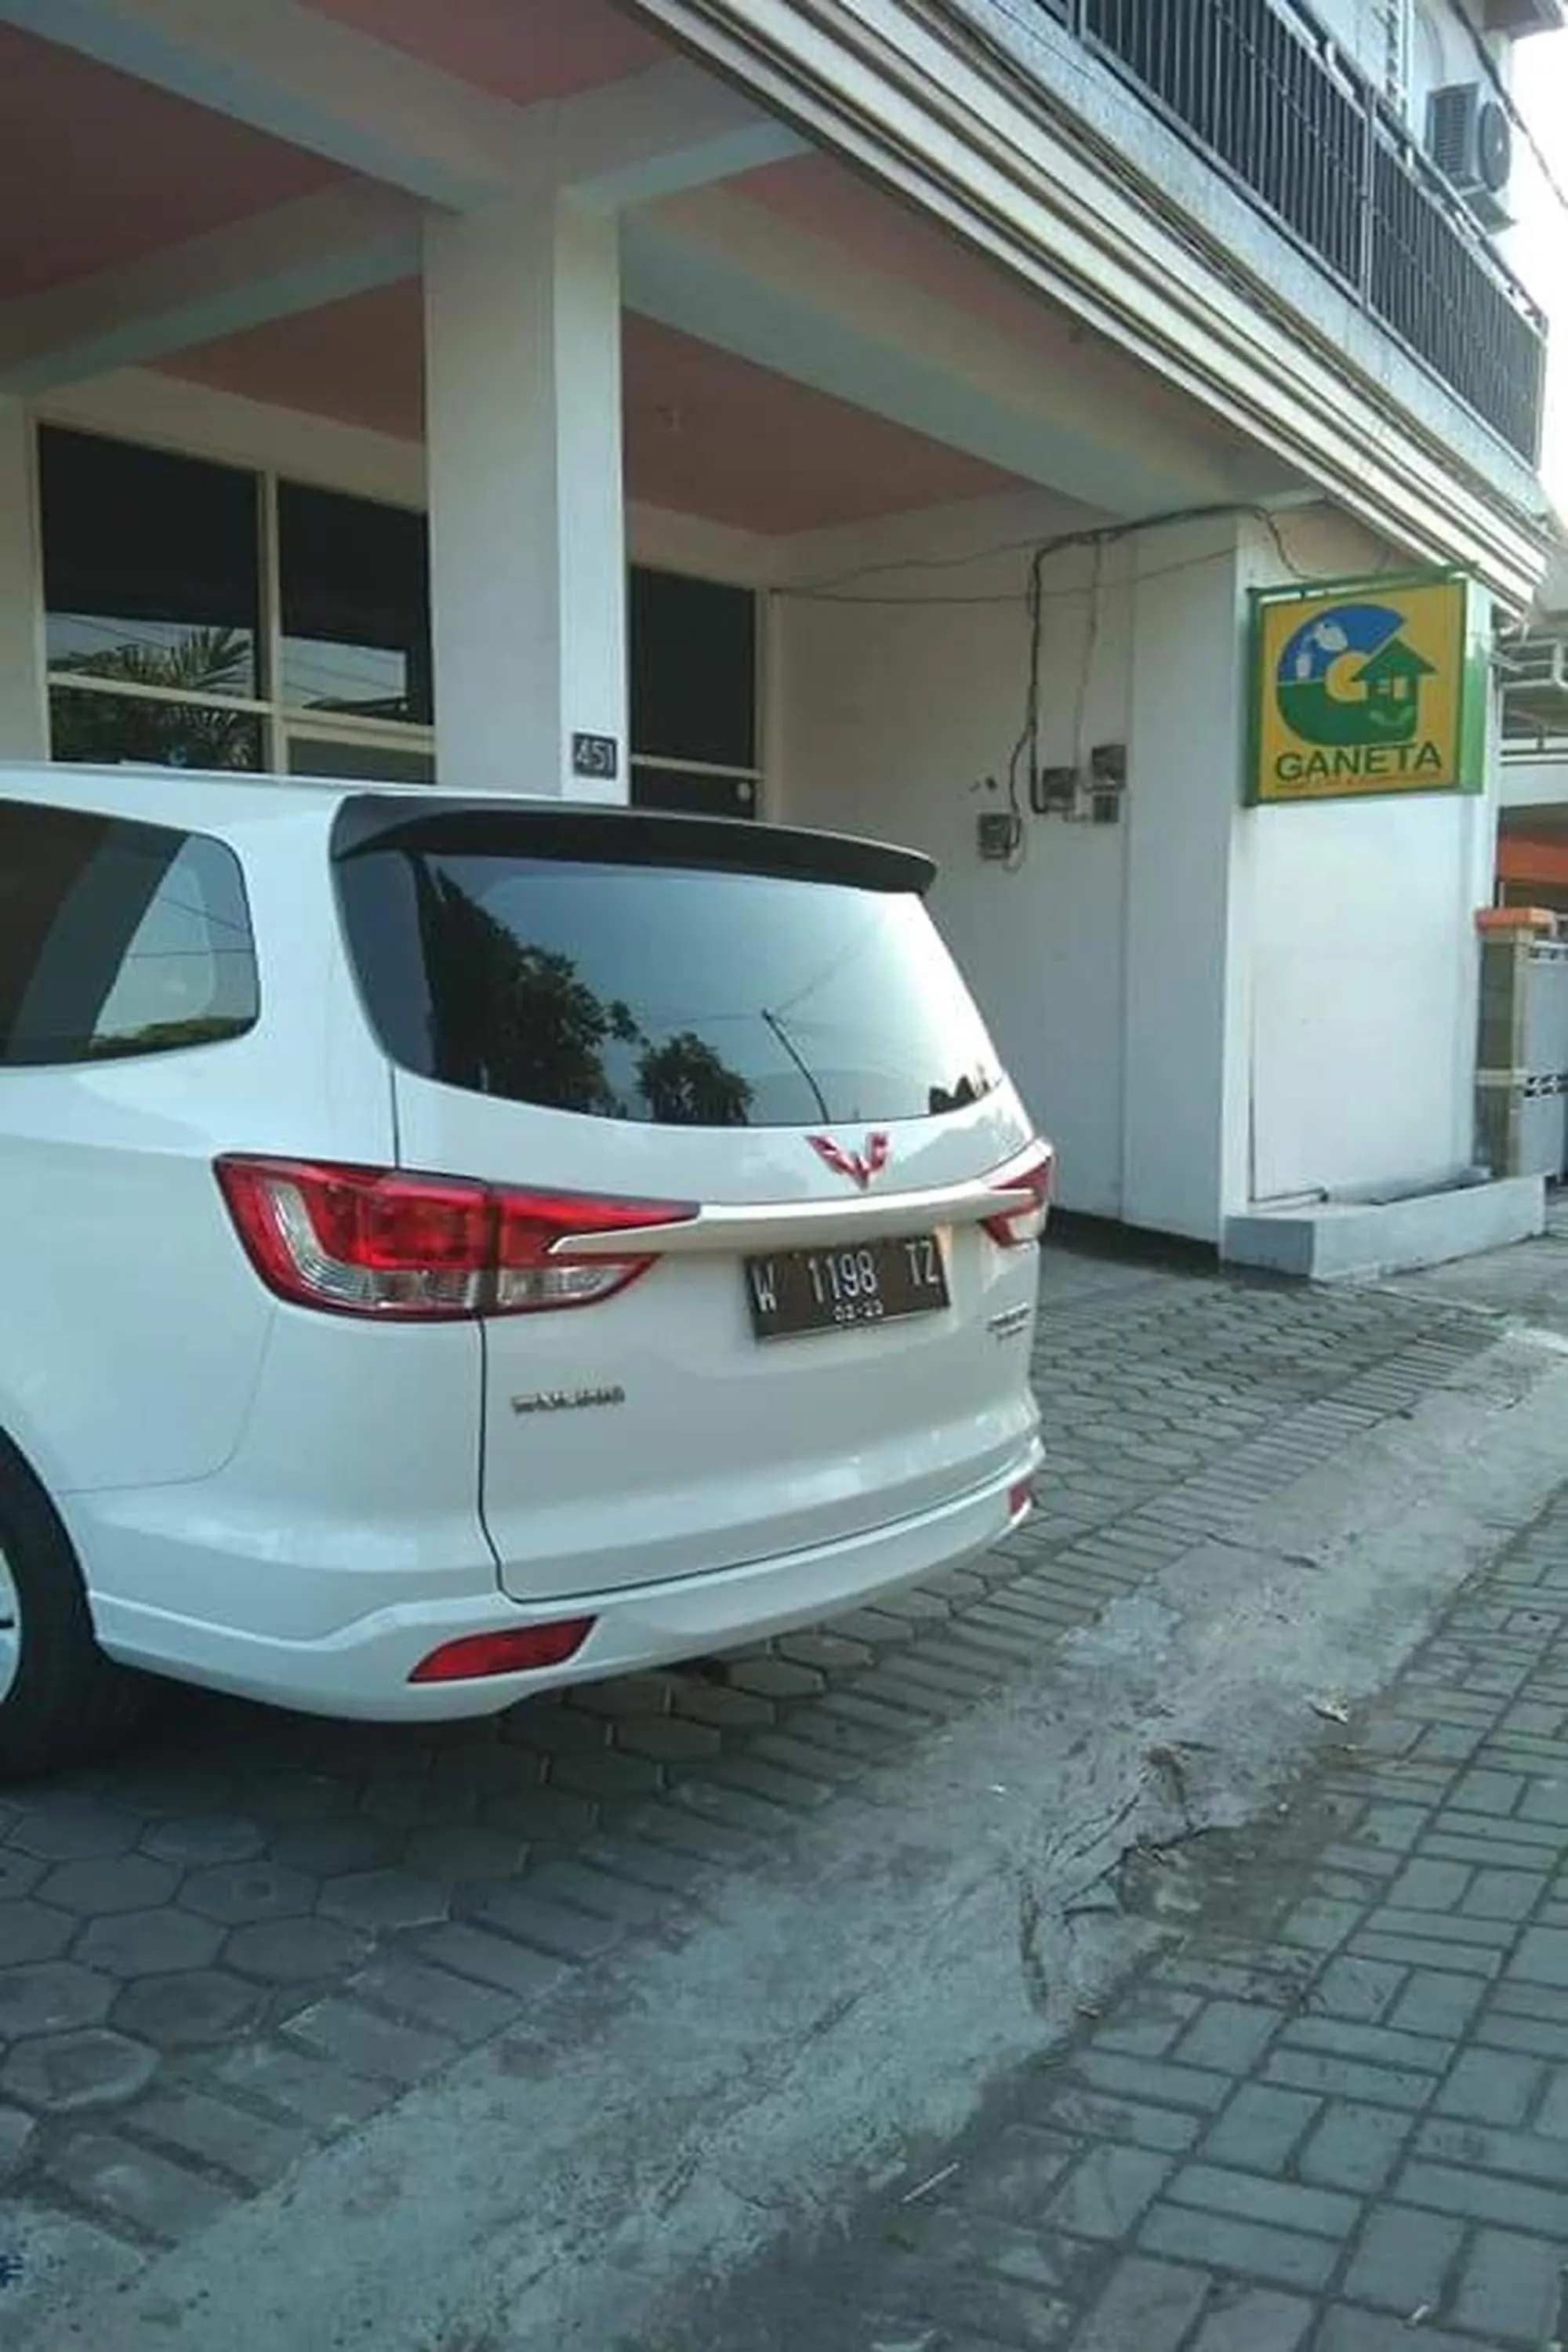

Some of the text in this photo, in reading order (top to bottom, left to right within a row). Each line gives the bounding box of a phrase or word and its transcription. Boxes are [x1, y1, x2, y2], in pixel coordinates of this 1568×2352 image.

[1275, 740, 1443, 782] GANETA
[753, 1240, 939, 1312] W 1198 TZ
